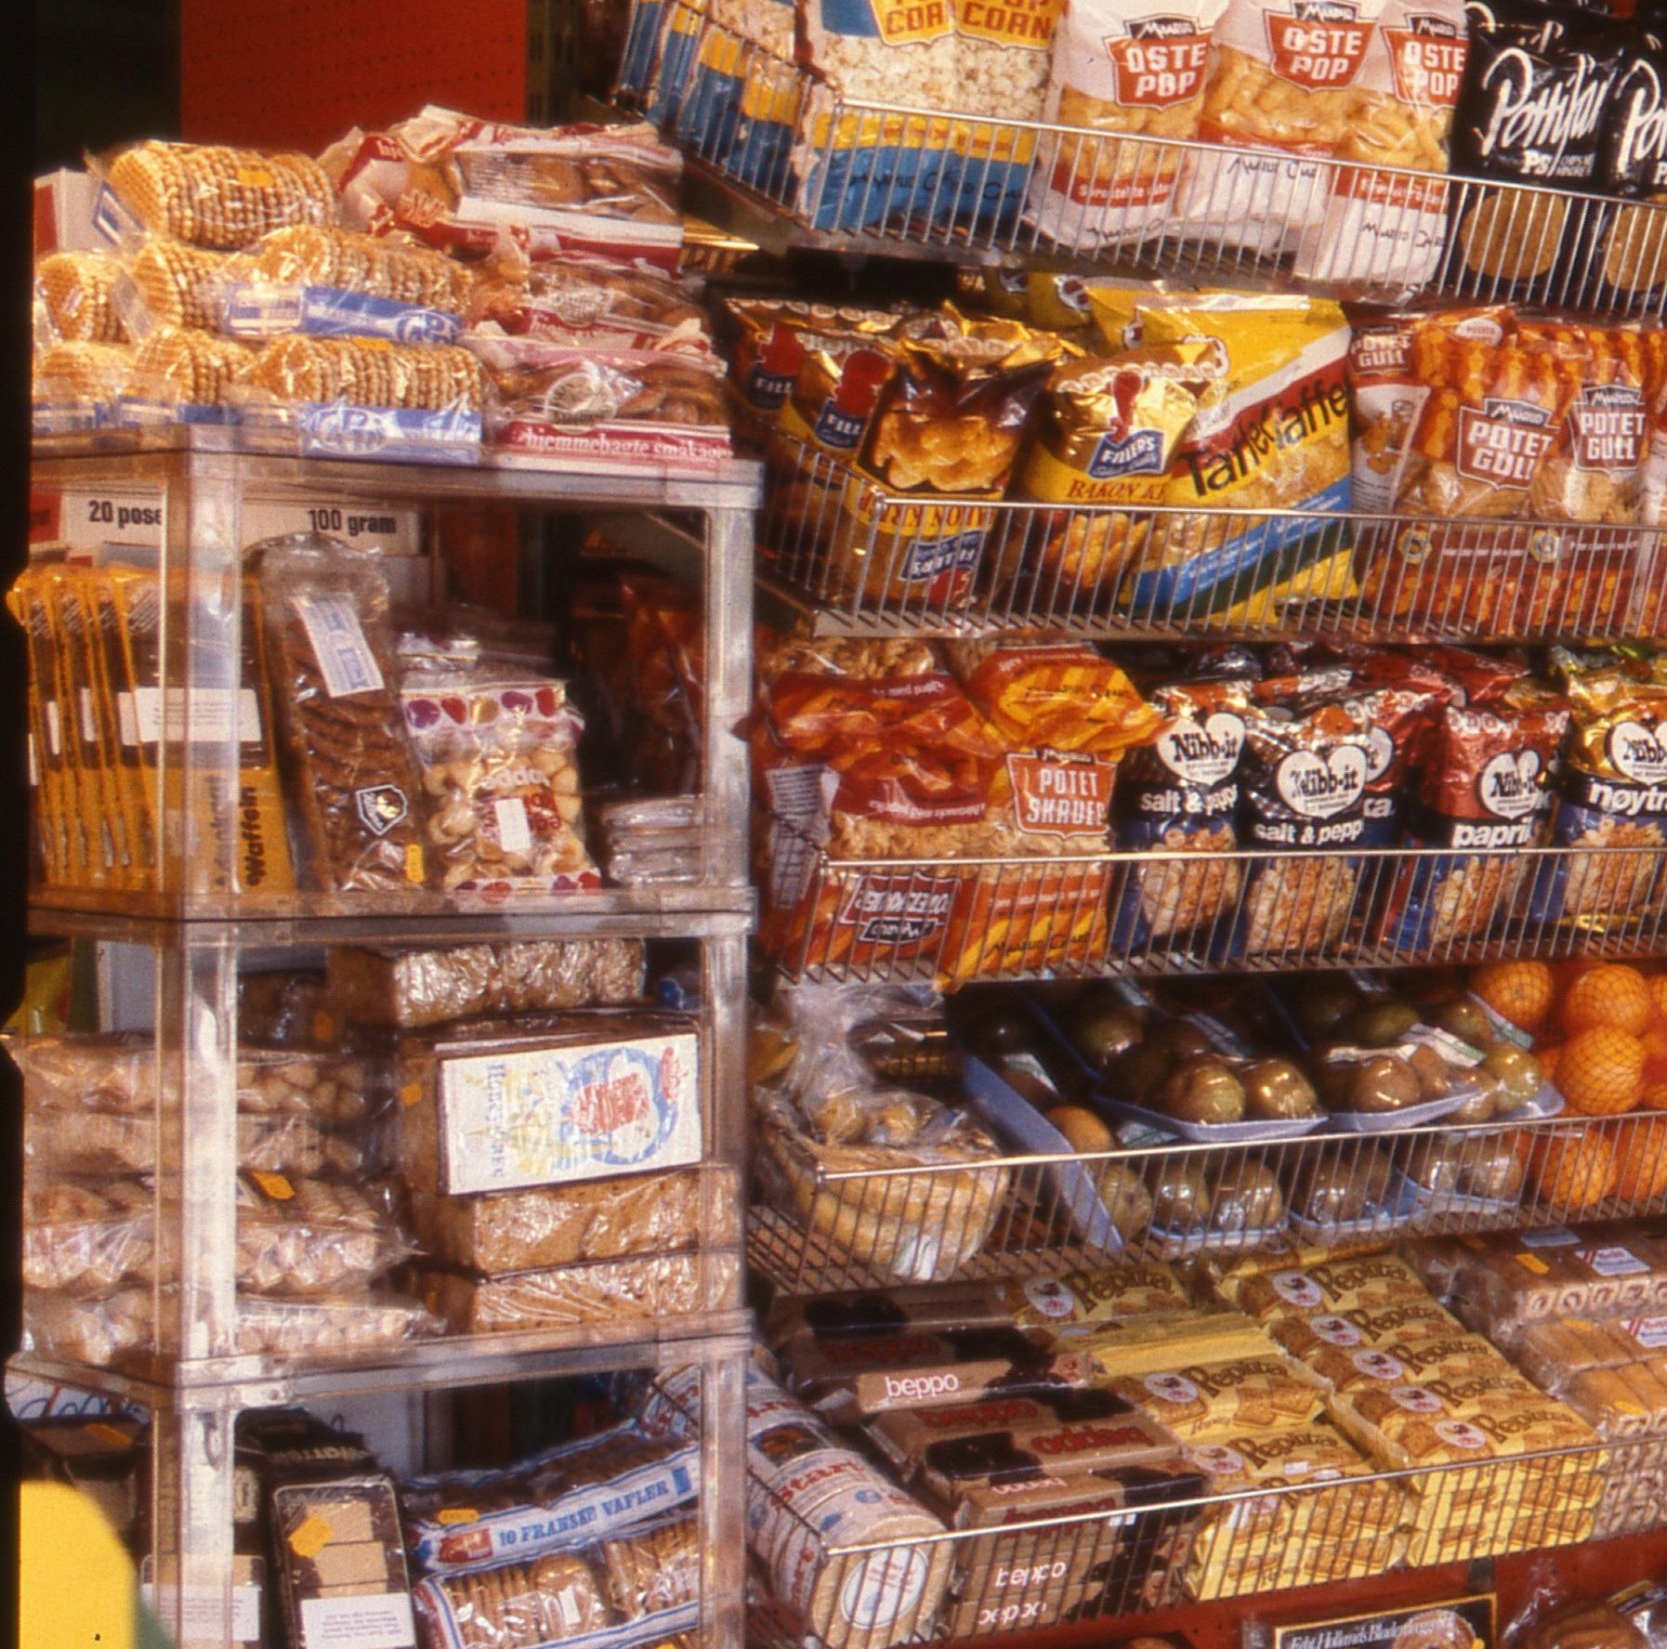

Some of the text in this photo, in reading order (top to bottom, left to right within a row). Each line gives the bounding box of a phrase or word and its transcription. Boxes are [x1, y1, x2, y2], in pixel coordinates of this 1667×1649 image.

[886, 5, 946, 36] COR
[962, 2, 1053, 41] CORN
[1282, 26, 1364, 55] OSTE
[1125, 41, 1207, 73] OSTE
[1289, 56, 1350, 82] POP
[1404, 40, 1466, 72] OSTE
[1135, 72, 1197, 99] POP
[1467, 419, 1554, 455] POTET
[1580, 410, 1645, 438] POTET
[1585, 435, 1637, 461] GULL
[88, 500, 113, 524] 20
[307, 508, 397, 536] 100 gram
[1170, 731, 1238, 764] Nibb-it
[1039, 766, 1098, 798] POTET
[1140, 788, 1178, 814] salt
[1256, 820, 1294, 843] salt
[1316, 819, 1363, 844] pepp
[884, 1371, 960, 1402] beppo
[498, 1480, 669, 1547] 10 FRANSKE VAFLER
